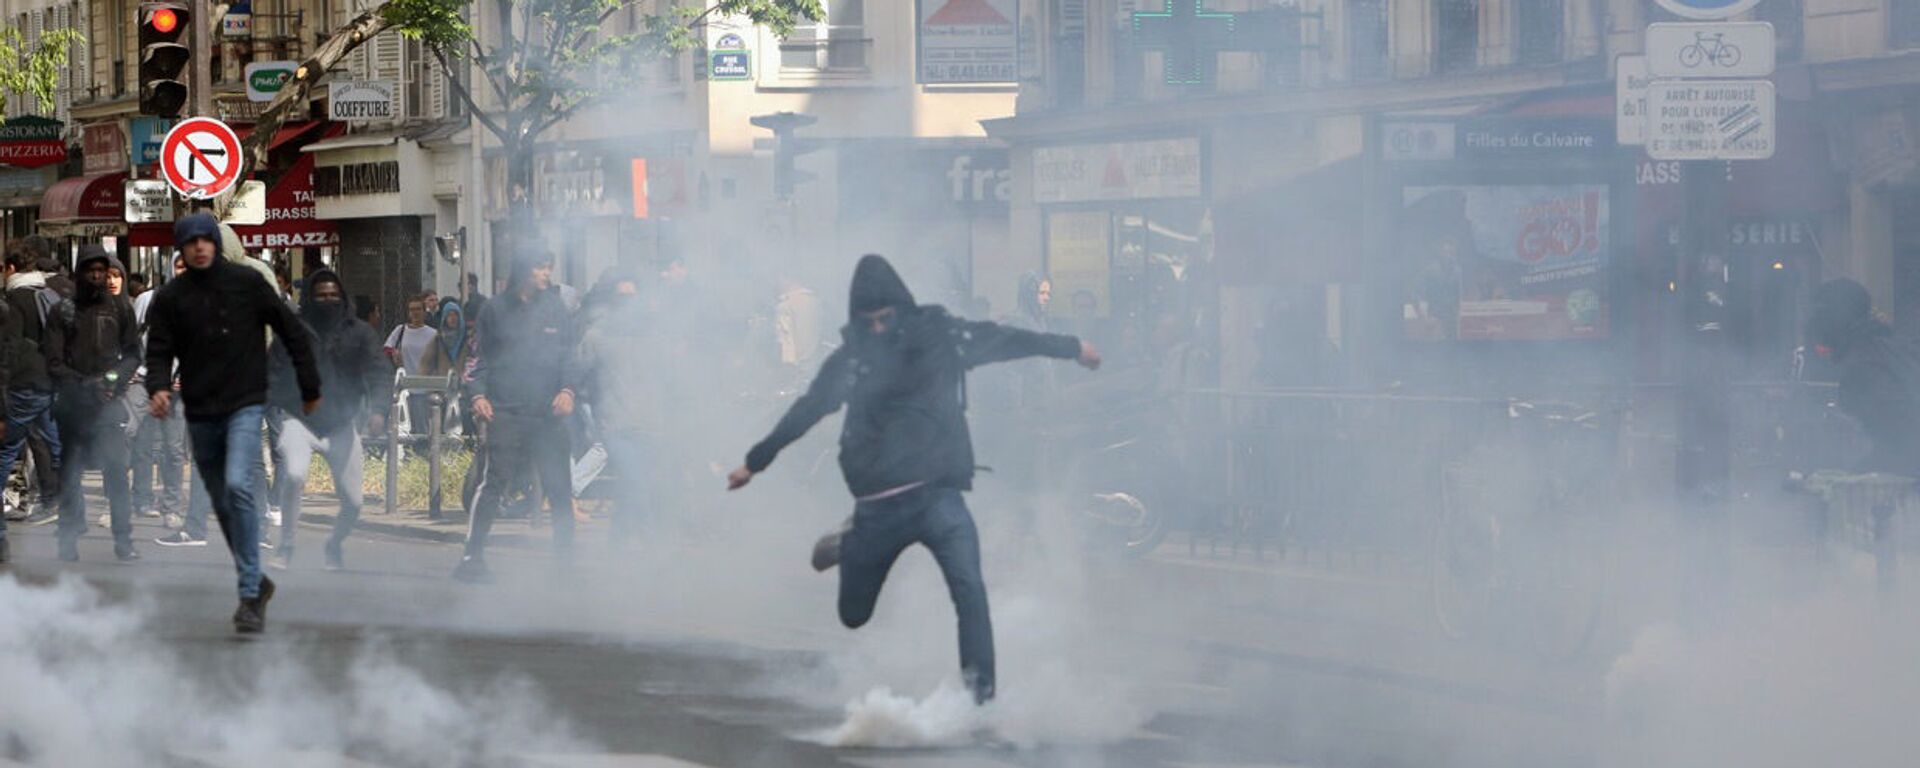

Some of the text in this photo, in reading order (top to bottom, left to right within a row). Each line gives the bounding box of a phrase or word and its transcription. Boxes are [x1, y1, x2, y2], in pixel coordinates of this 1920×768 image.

[334, 100, 391, 117] COIFFURE
[1661, 106, 1690, 118] POUR
[1466, 132, 1594, 148] Filles du Calvaire
[1, 143, 65, 157] PIZZERIA
[141, 197, 170, 208] TEMPLE
[85, 224, 120, 235] PIZZA
[242, 231, 340, 247] LE BRAZZA
